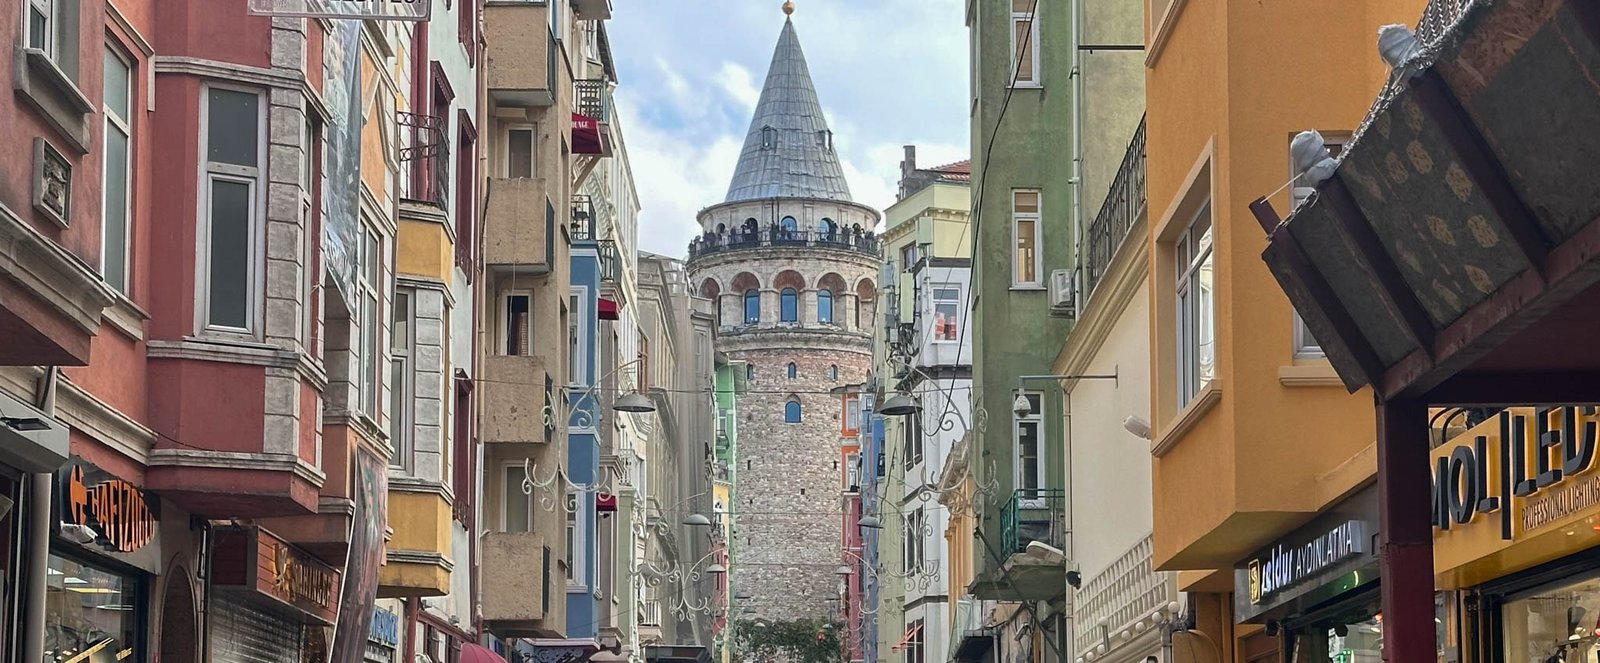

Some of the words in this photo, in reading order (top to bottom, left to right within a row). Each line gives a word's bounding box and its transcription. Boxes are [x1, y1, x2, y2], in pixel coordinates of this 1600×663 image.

[1522, 489, 1570, 533] PROFESSIONAL
[1570, 475, 1600, 513] LIGHTING
[1295, 520, 1353, 580] AYDINLATMA
